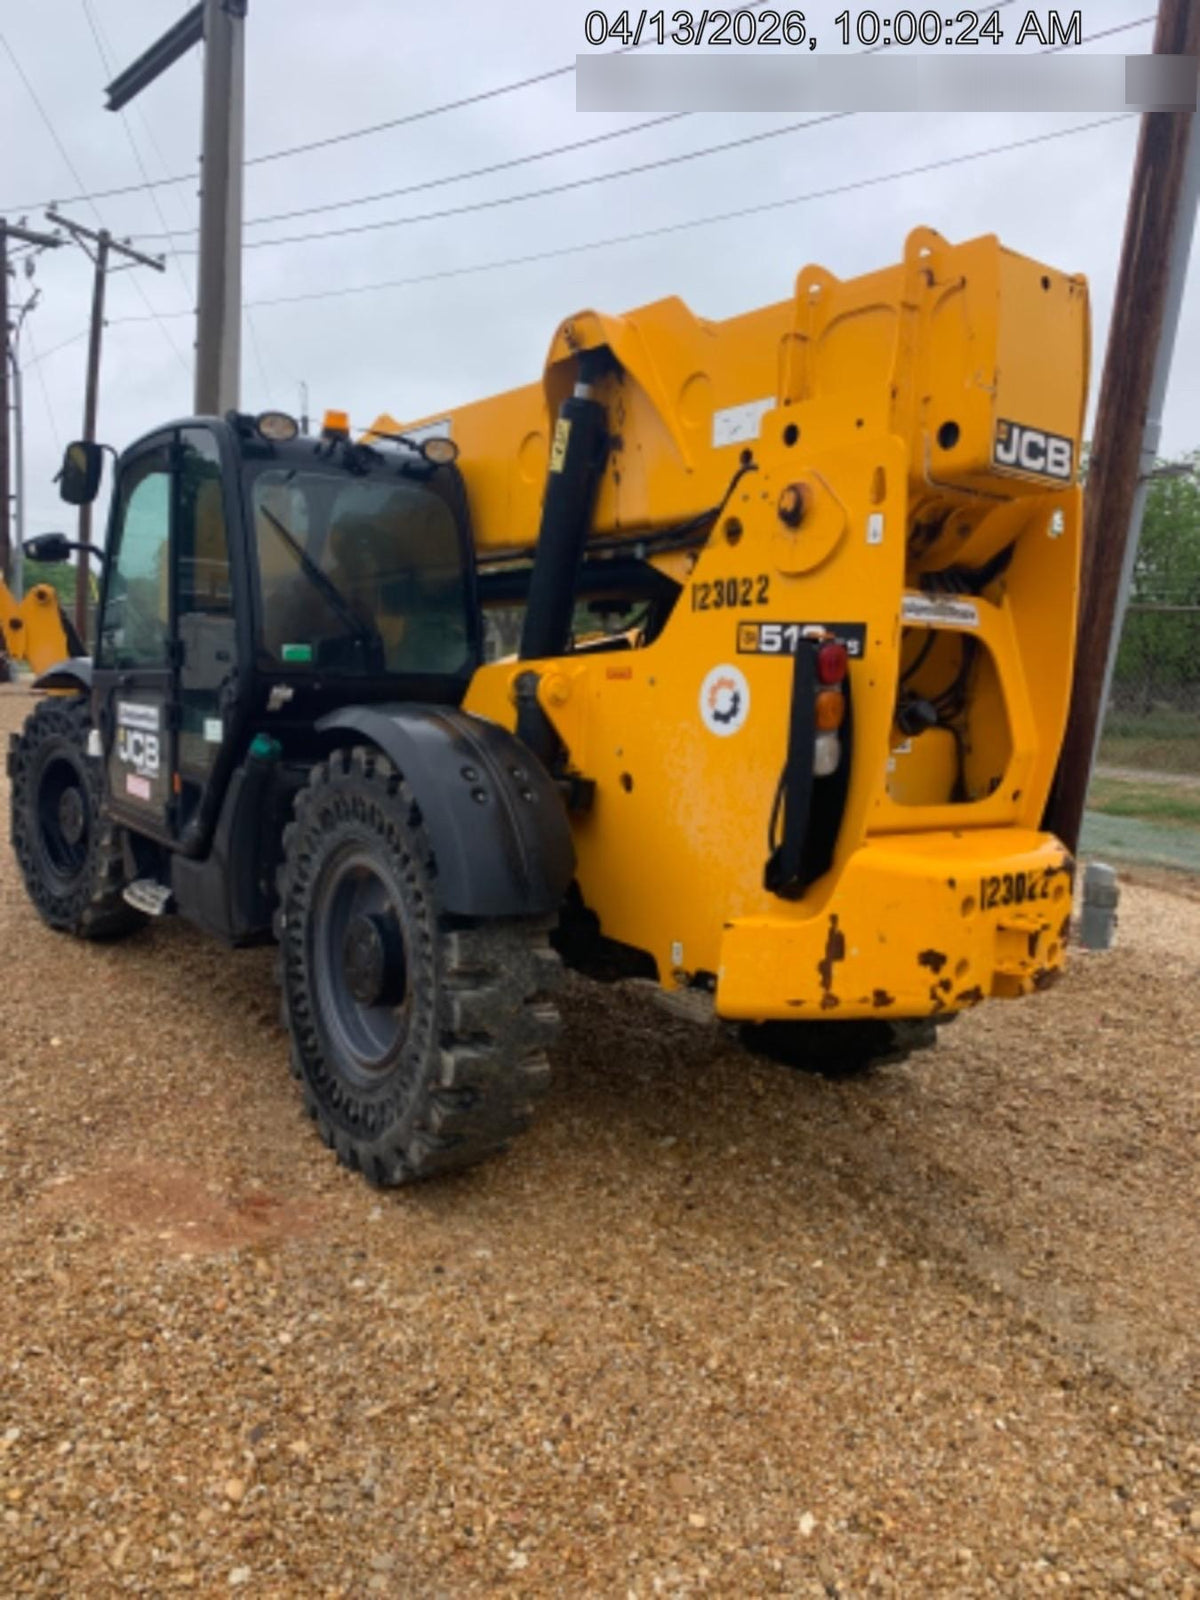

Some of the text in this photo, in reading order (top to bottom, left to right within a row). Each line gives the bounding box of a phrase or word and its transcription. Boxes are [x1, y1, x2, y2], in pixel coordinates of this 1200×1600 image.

[996, 425, 1071, 478] JCB
[692, 575, 769, 612] 123022
[119, 728, 159, 769] JCB
